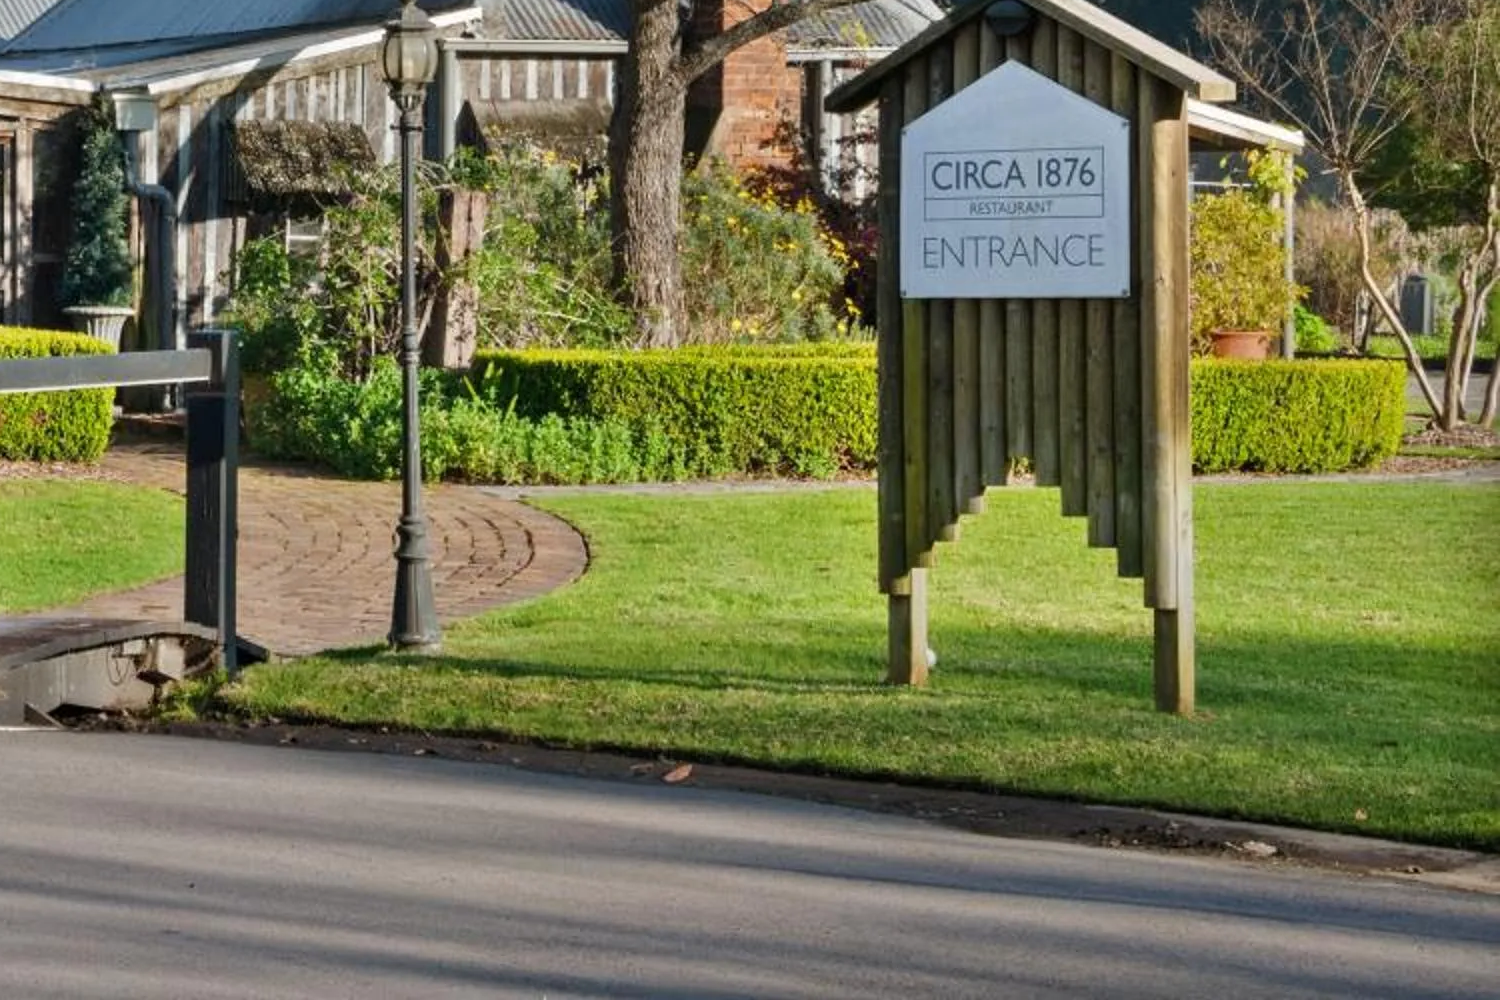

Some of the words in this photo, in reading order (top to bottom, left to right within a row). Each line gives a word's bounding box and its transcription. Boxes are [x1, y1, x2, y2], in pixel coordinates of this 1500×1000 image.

[931, 160, 1026, 190] CIRCA
[1037, 157, 1096, 188] 1876
[969, 200, 1052, 216] RESTAURANT
[923, 234, 1105, 268] ENTRANCE
